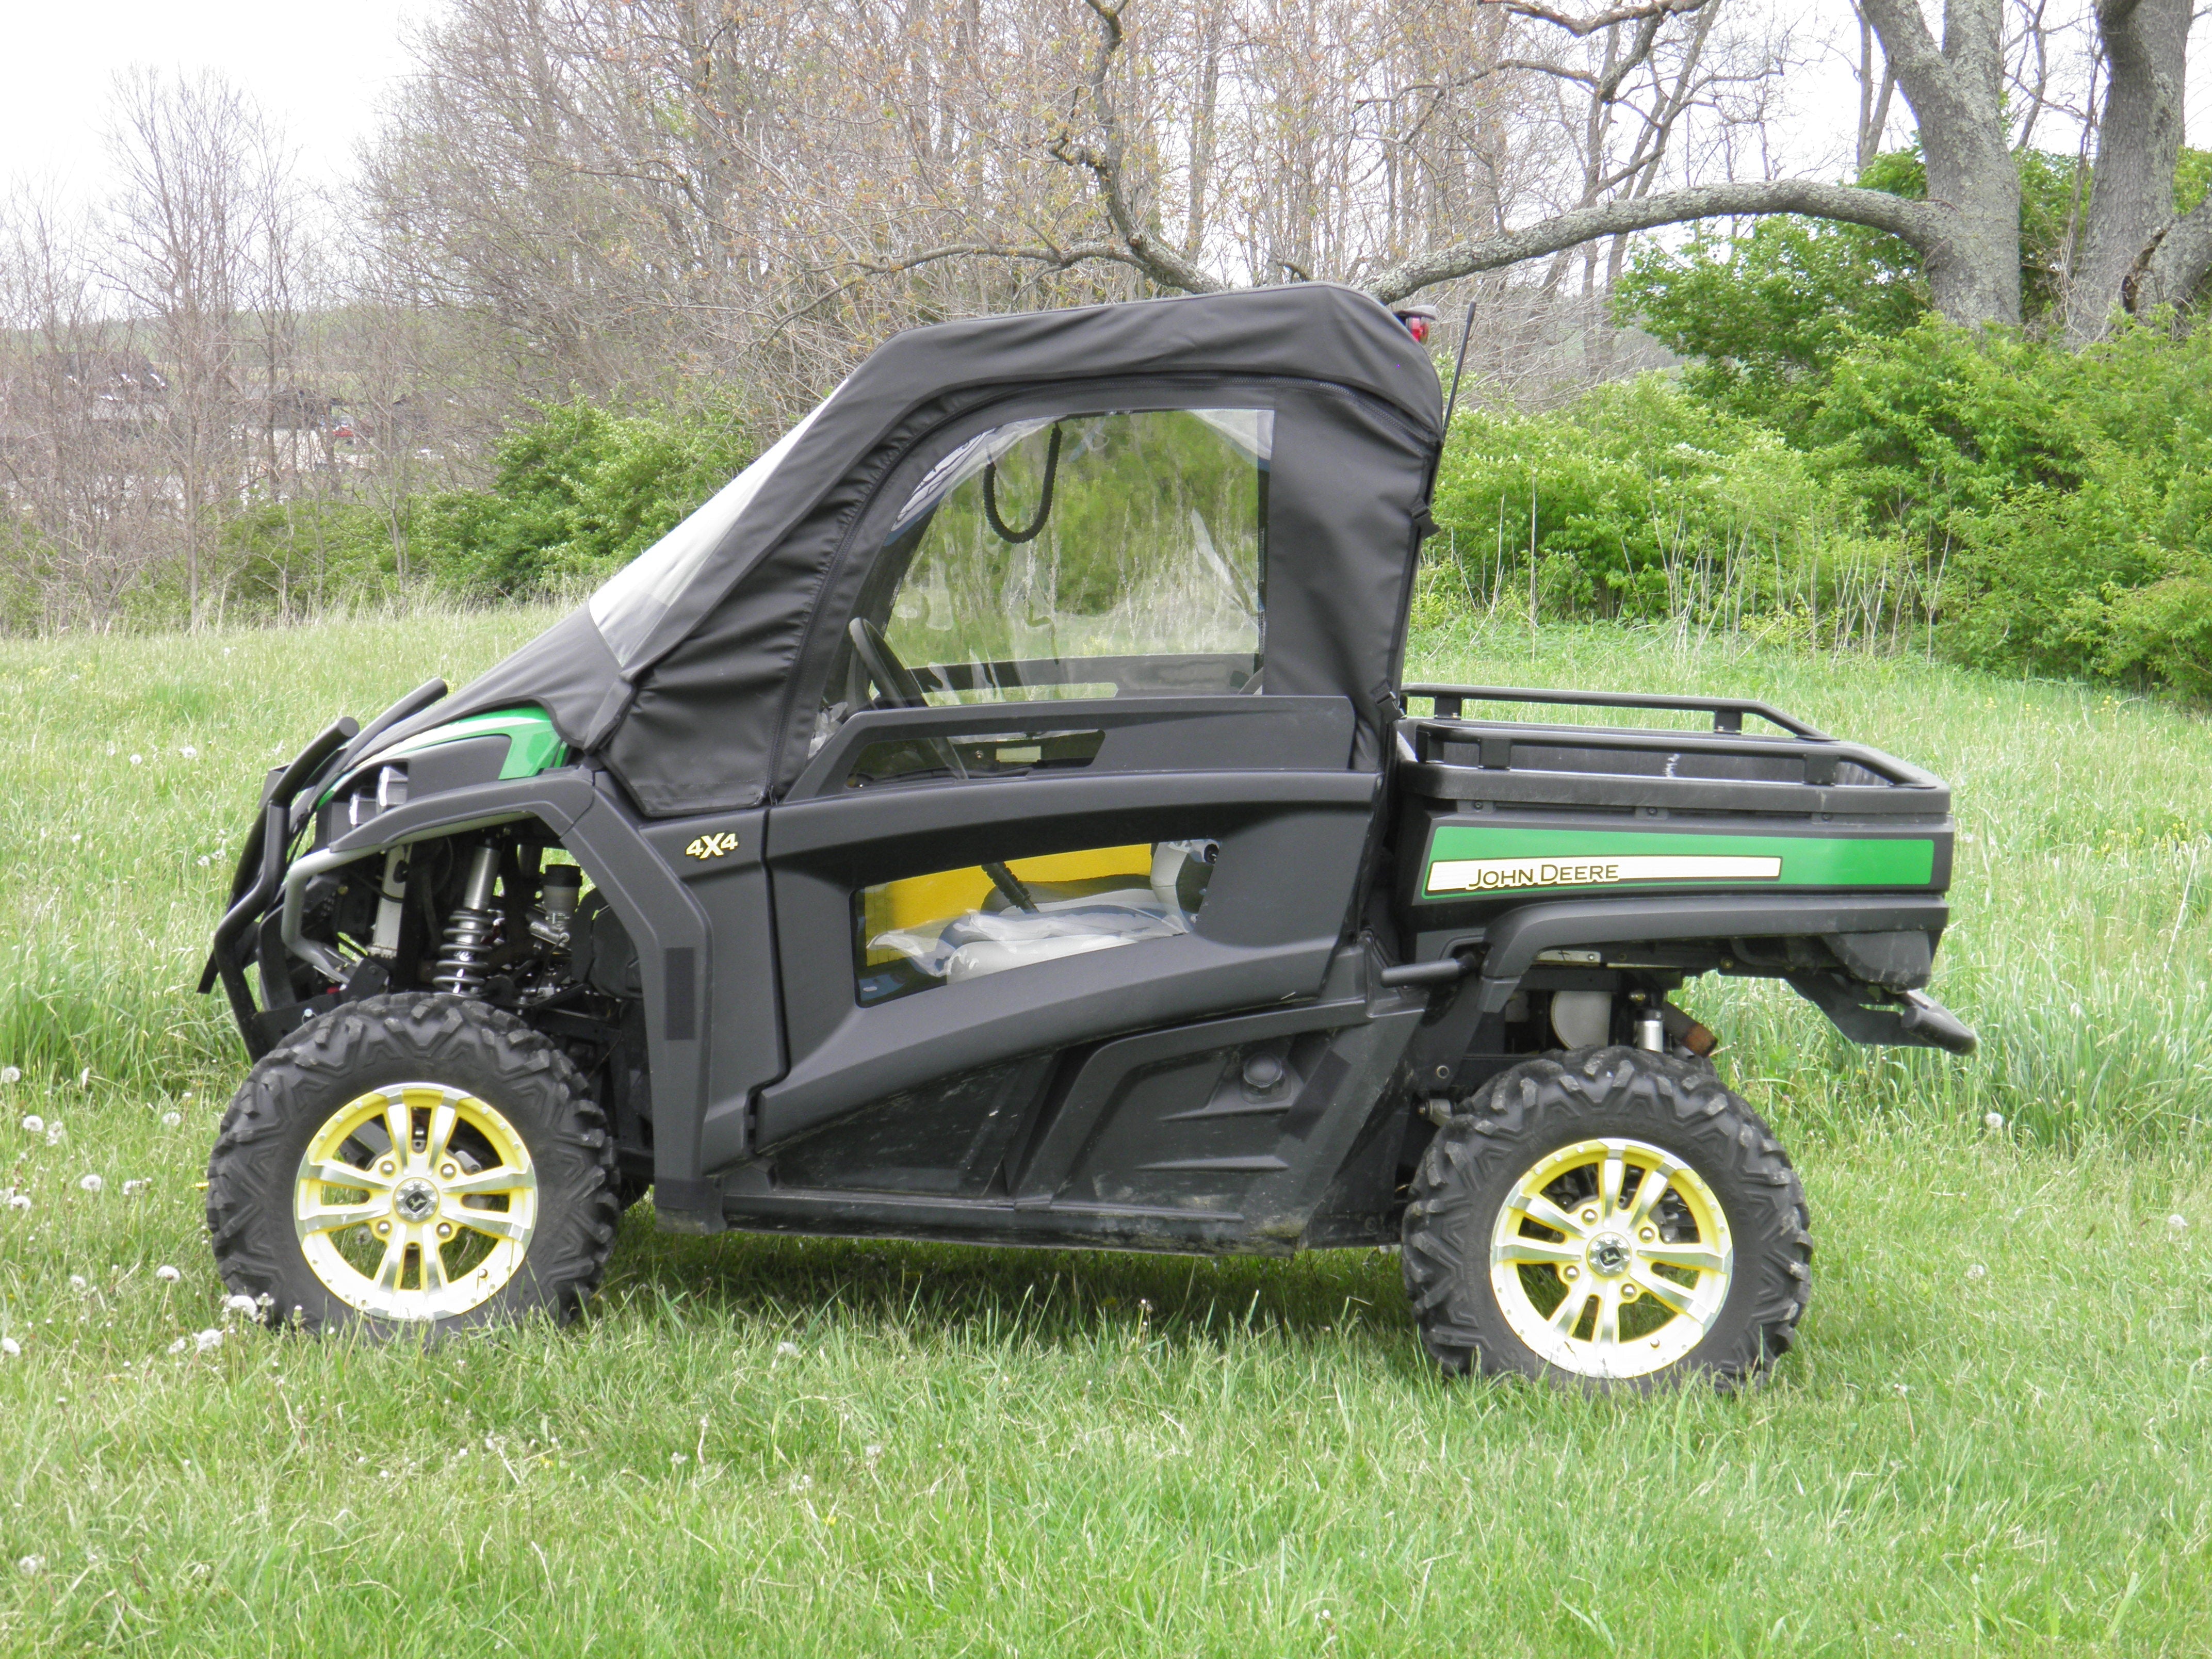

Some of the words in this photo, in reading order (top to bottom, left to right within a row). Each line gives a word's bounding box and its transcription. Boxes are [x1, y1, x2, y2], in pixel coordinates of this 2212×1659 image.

[686, 832, 738, 859] 4X4
[1468, 869, 1534, 887] JOHN
[1541, 864, 1619, 882] DEERE
